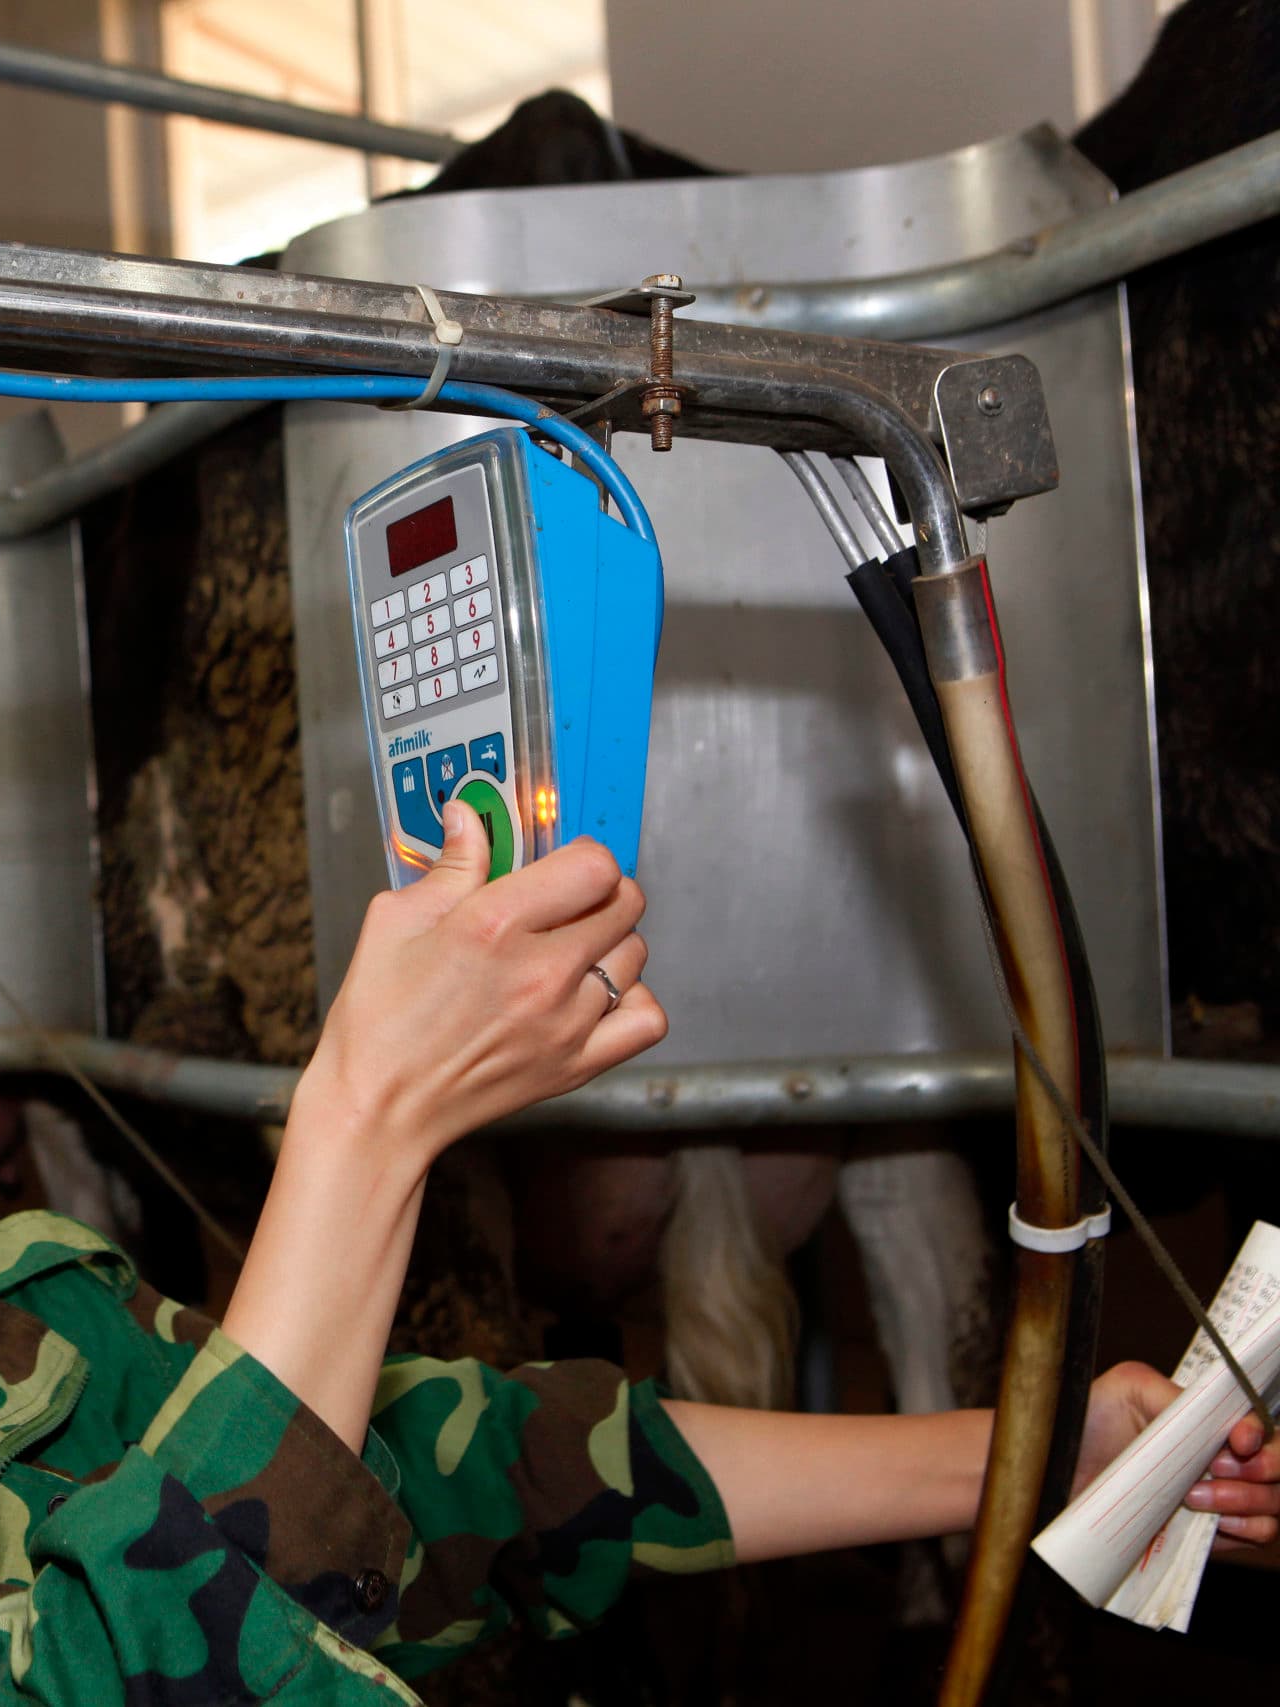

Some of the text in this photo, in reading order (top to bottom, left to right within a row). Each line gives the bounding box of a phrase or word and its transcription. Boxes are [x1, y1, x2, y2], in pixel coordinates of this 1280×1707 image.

[385, 565, 473, 618] 1 2 3
[388, 597, 477, 649] 4 5 6
[391, 630, 480, 681] 7 8 9
[434, 678, 442, 698] 0
[388, 729, 431, 758] afimilk
